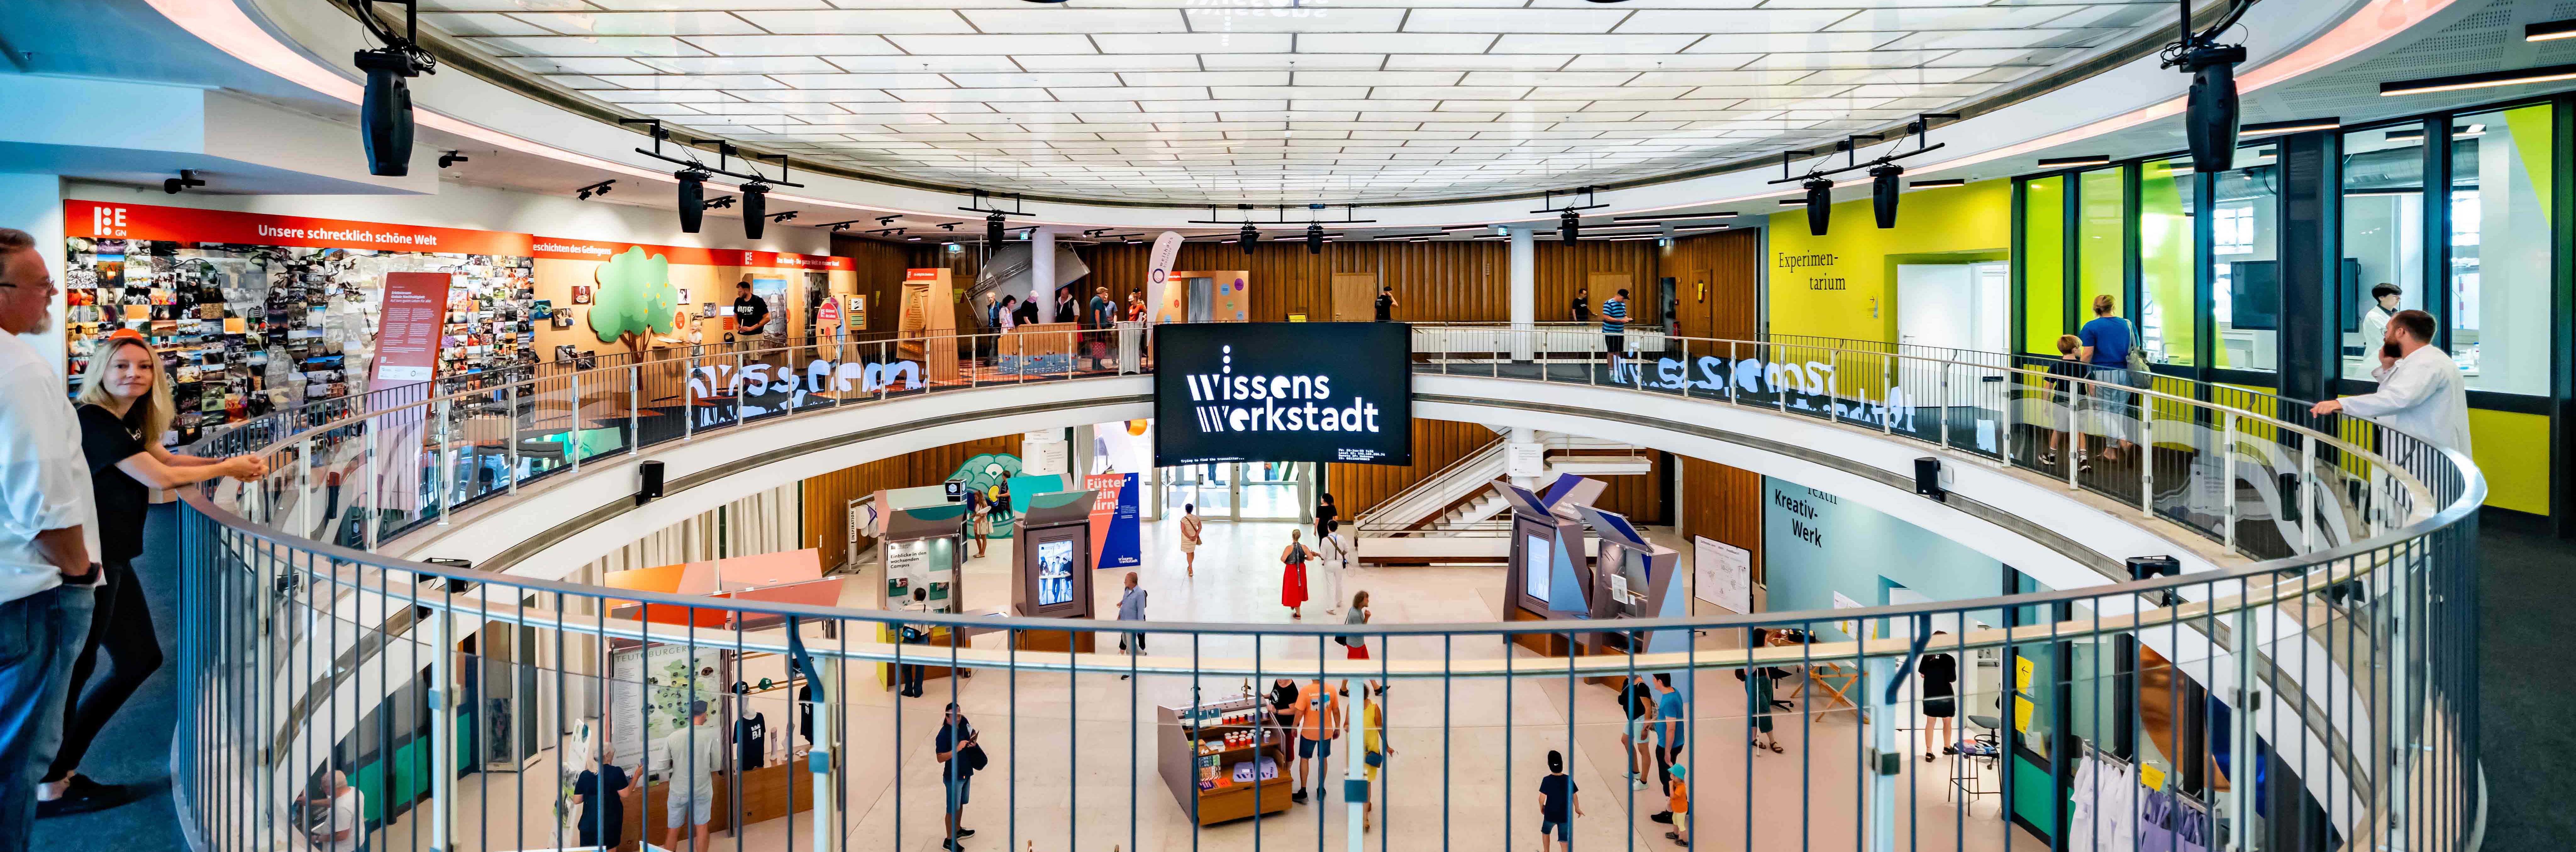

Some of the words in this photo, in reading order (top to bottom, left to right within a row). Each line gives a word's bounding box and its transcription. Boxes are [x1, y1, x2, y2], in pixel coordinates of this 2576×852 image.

[258, 224, 304, 238] Unsere
[307, 228, 373, 242] schrecklich
[375, 232, 412, 244] schöne
[414, 234, 437, 245] Welt
[533, 243, 569, 252] eschichten
[570, 245, 581, 253] des
[582, 245, 612, 256] Gelingens
[1159, 236, 1174, 267] welthaus
[1779, 250, 1839, 273] Experimen-
[1810, 273, 1846, 290] tarium
[1097, 488, 1115, 500] ein
[1775, 488, 1818, 520] Kreativ-
[1792, 518, 1822, 548] Werk
[752, 729, 761, 740] BI
